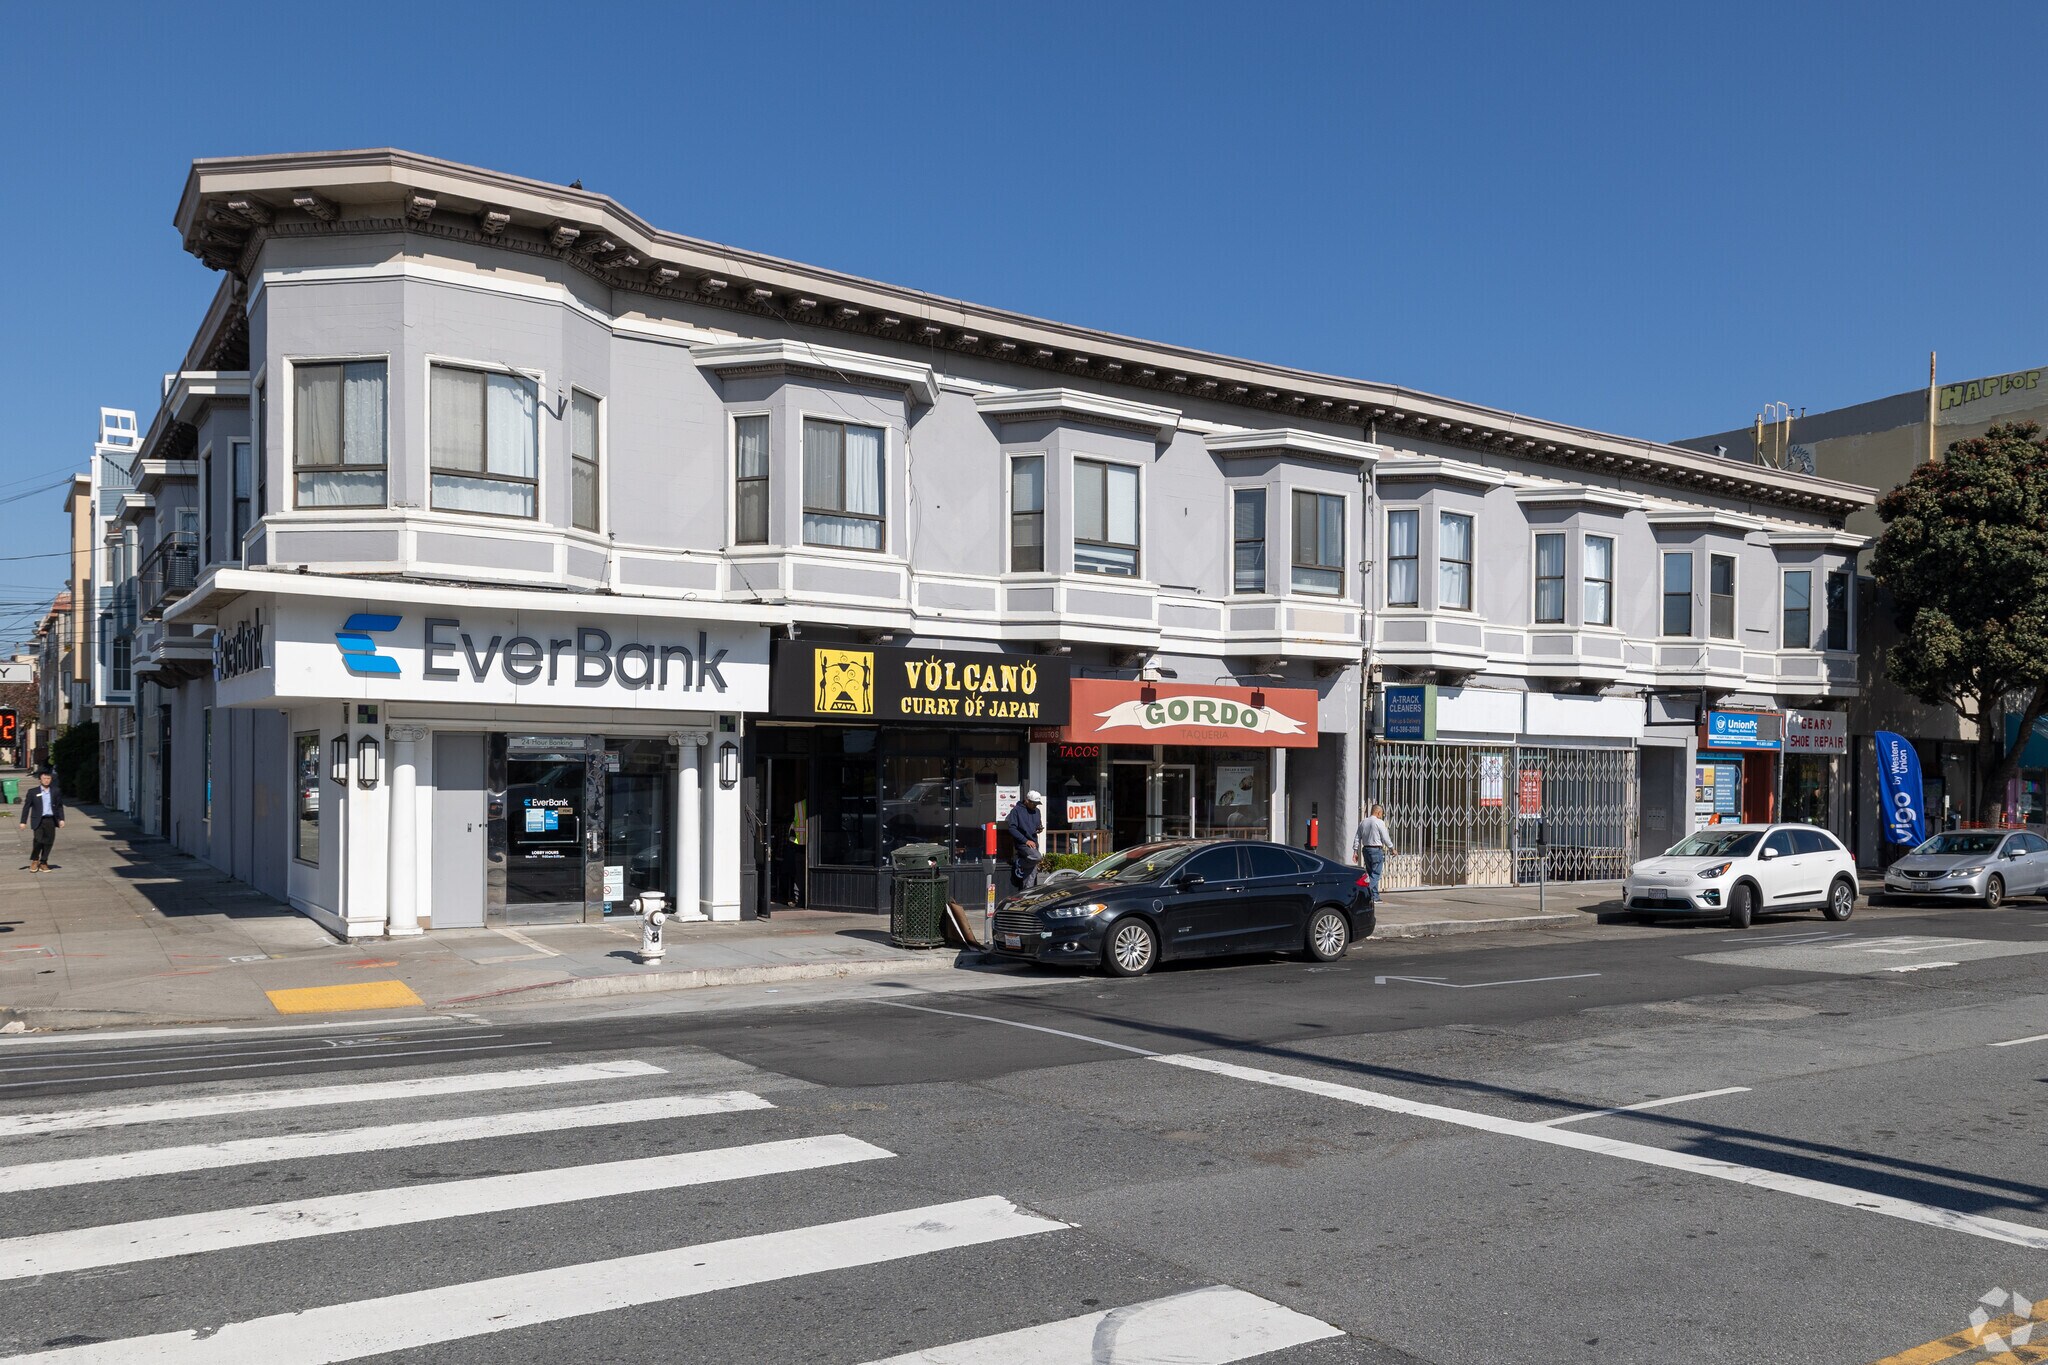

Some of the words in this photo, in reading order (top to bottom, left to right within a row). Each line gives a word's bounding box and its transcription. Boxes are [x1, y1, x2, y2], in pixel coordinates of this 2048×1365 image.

[221, 608, 264, 680] EverBank
[425, 618, 728, 688] EverBank
[904, 656, 1037, 695] VOLCANO
[901, 697, 959, 715] CURRY
[964, 694, 985, 717] OF
[989, 700, 1040, 718] JAPAN
[1392, 695, 1419, 704] A-TRACK
[1145, 700, 1259, 728] GORDO
[1389, 704, 1422, 713] CLEANERS
[1801, 718, 1832, 730] GEARY
[1181, 729, 1228, 740] TAQUERIA
[1790, 735, 1810, 747] SHOE
[1814, 736, 1844, 748] REPAIR
[1060, 745, 1099, 758] TACOS
[1891, 740, 1899, 774] Western
[1900, 749, 1908, 774] Union
[1893, 775, 1902, 785] by
[532, 798, 569, 806] EverBank
[1069, 805, 1094, 820] OPEN
[1890, 792, 1917, 844] vigo
